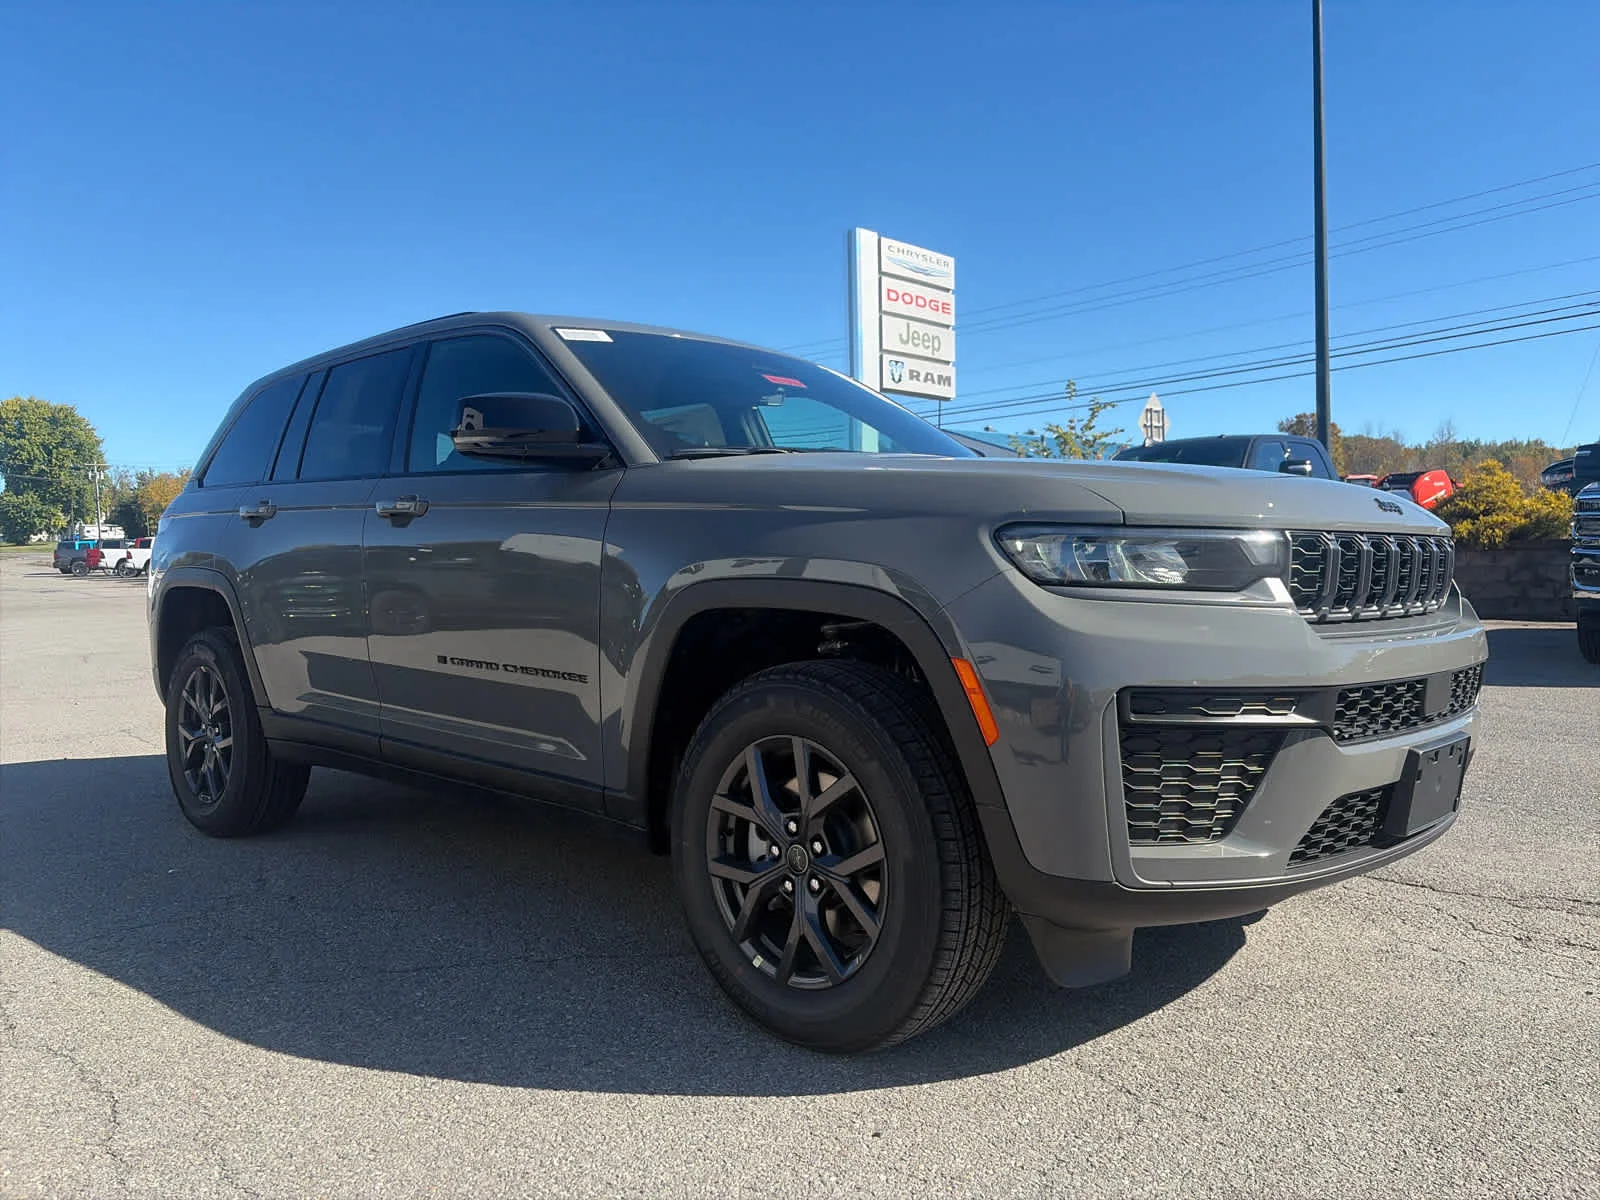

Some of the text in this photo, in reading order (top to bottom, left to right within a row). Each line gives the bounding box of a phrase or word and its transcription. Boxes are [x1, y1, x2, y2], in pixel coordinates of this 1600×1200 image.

[887, 245, 950, 268] CHRYSLER
[886, 288, 952, 315] DODGE
[899, 322, 941, 355] Jeep
[908, 369, 952, 387] RAM
[450, 656, 589, 684] GRAND CHEROKEE
